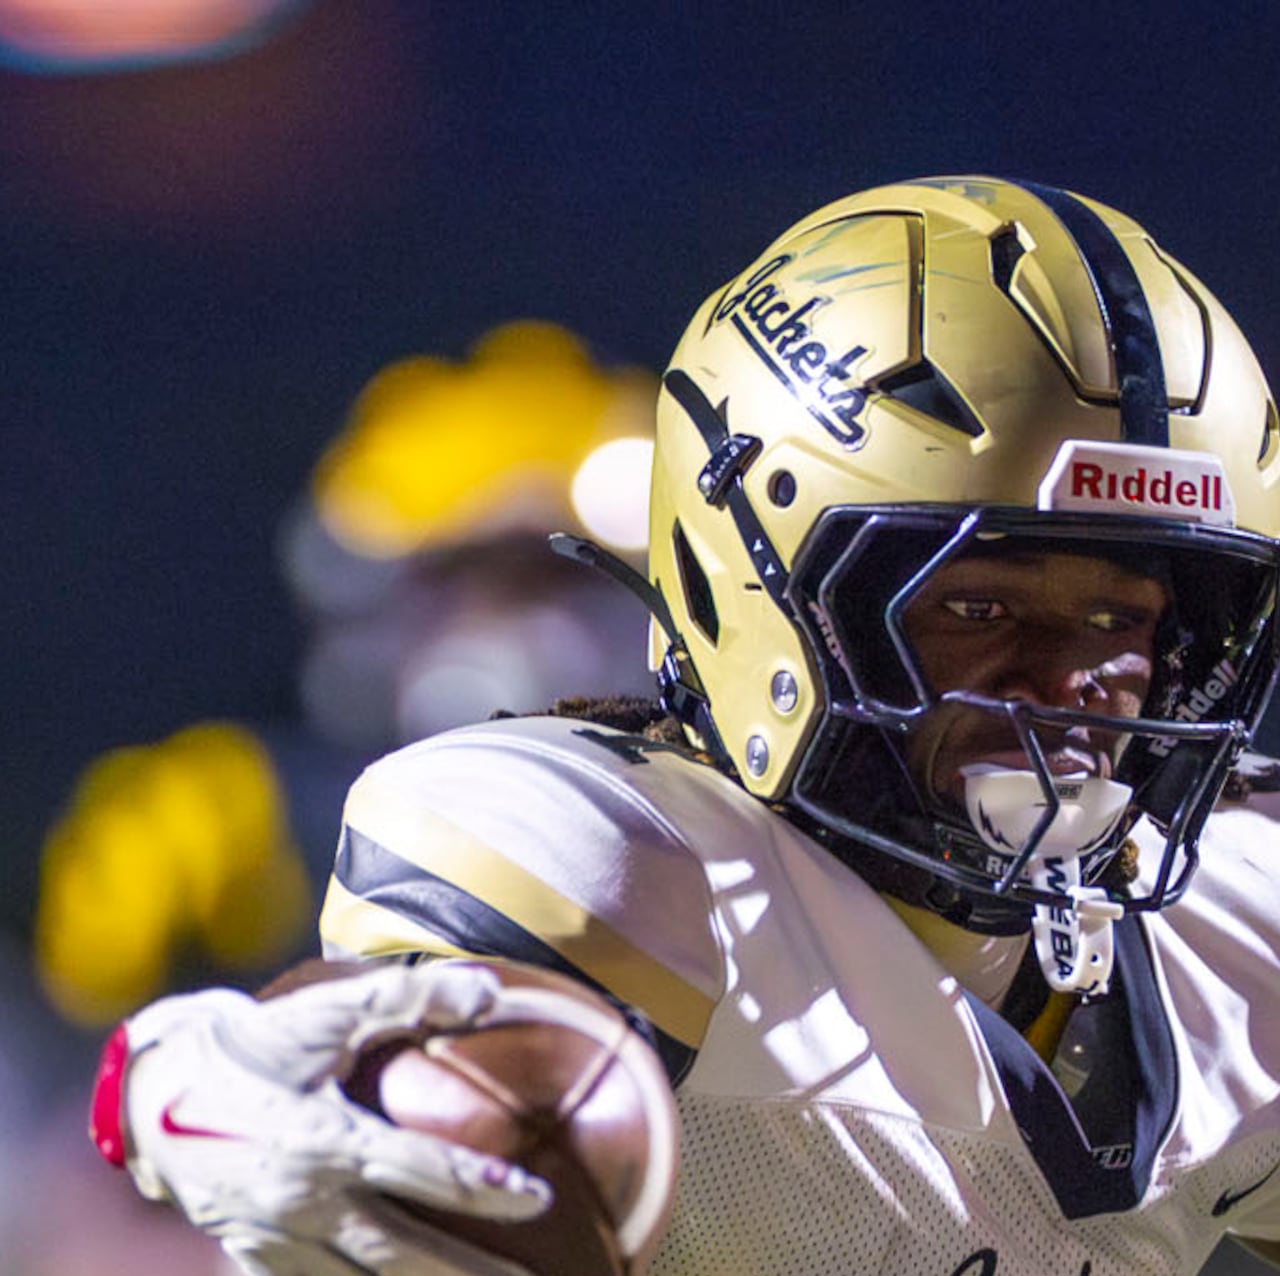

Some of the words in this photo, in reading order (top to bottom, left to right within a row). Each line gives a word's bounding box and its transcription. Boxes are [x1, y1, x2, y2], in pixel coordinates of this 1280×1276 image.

[716, 253, 870, 446] Jackets
[1072, 463, 1222, 510] Riddell
[1148, 658, 1239, 758] Rddell
